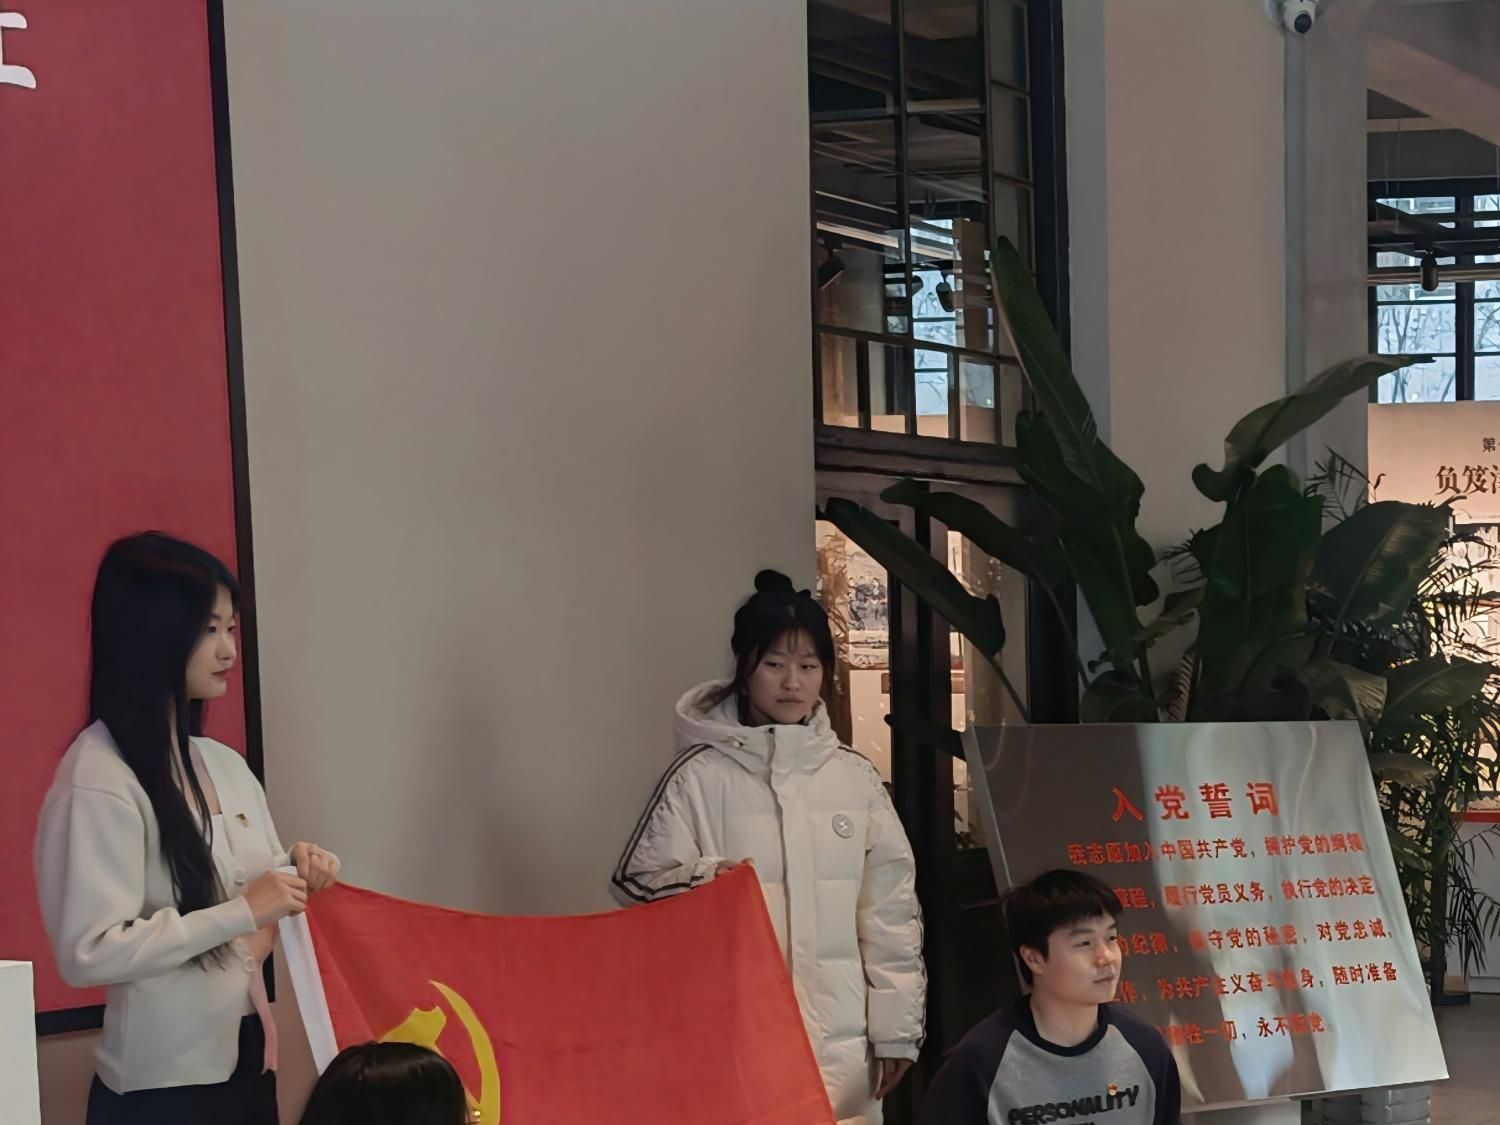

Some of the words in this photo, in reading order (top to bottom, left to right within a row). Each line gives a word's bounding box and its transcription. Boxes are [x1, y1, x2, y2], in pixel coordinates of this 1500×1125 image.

[1111, 782, 1279, 823] 入党誓词
[1007, 1084, 1139, 1125] PERSONALITY
